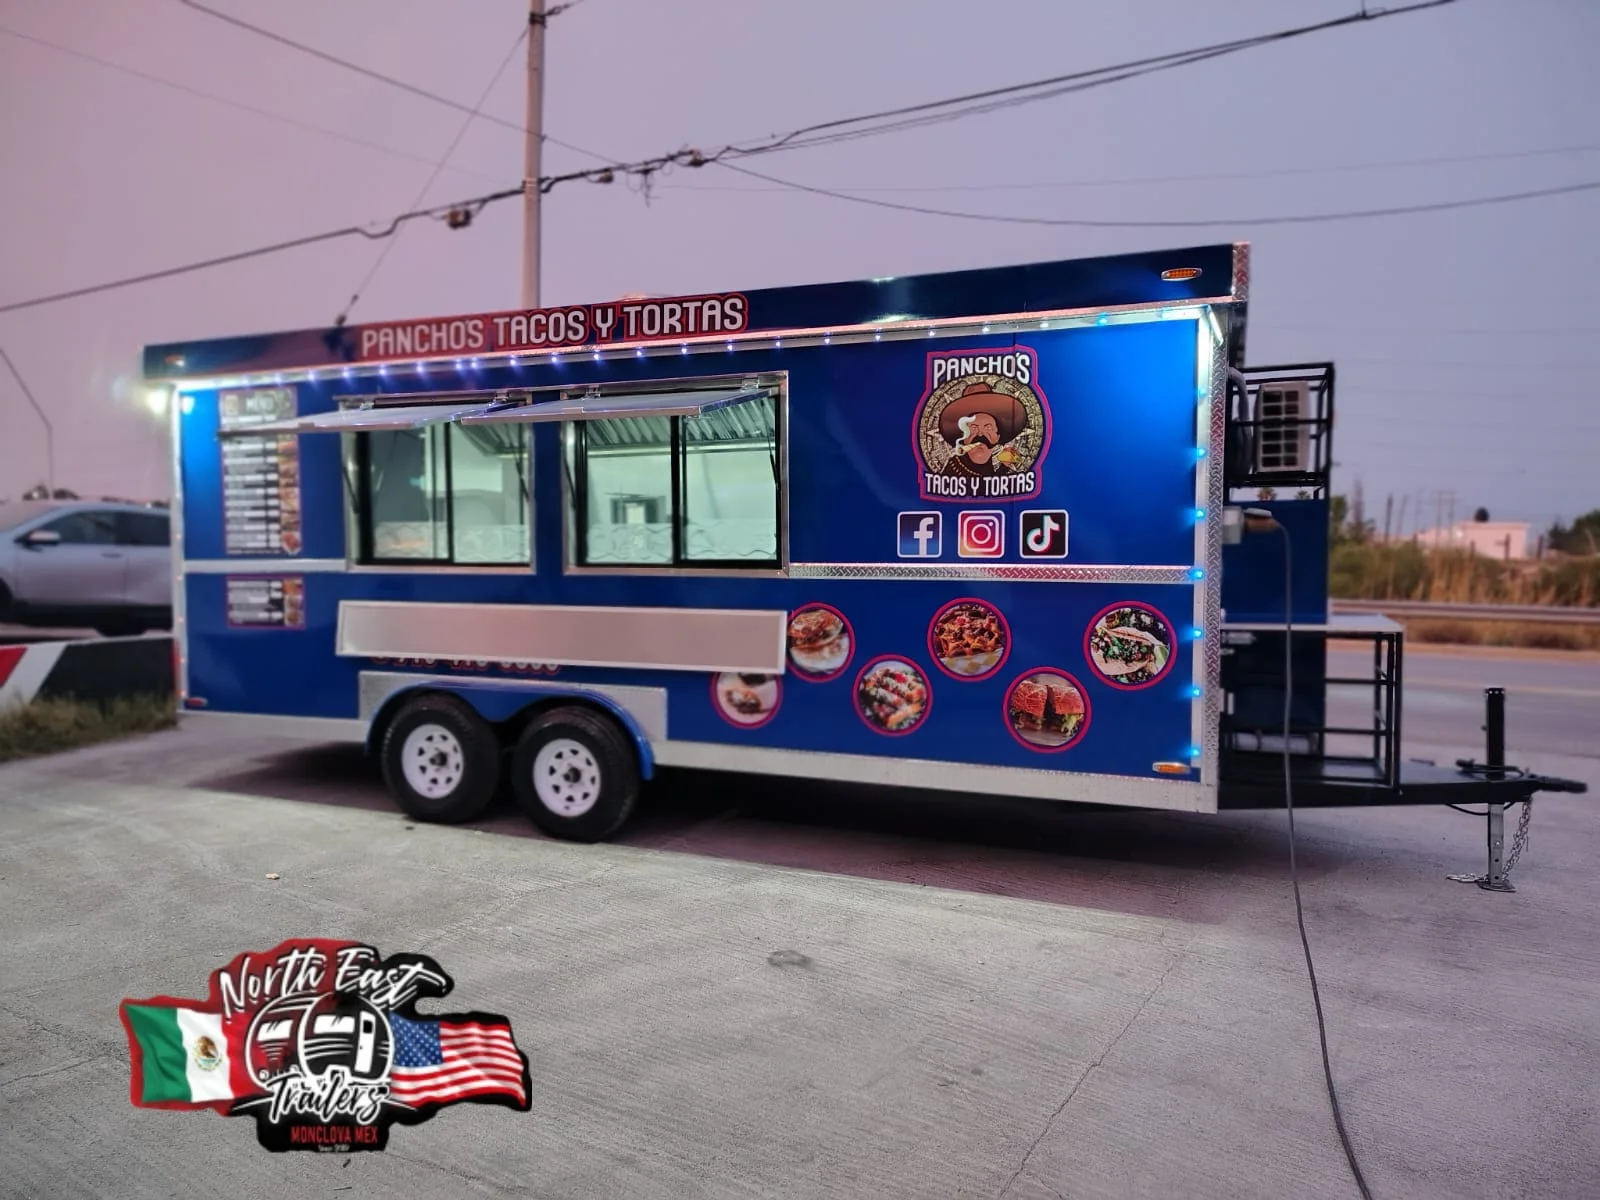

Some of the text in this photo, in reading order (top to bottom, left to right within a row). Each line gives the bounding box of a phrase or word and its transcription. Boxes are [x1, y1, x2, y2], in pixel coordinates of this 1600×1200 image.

[362, 297, 743, 357] PANCHO'S TACOS Y TORTAS
[932, 352, 1031, 389] PANCHO'S
[925, 472, 1035, 496] TACOS Y TORTAS
